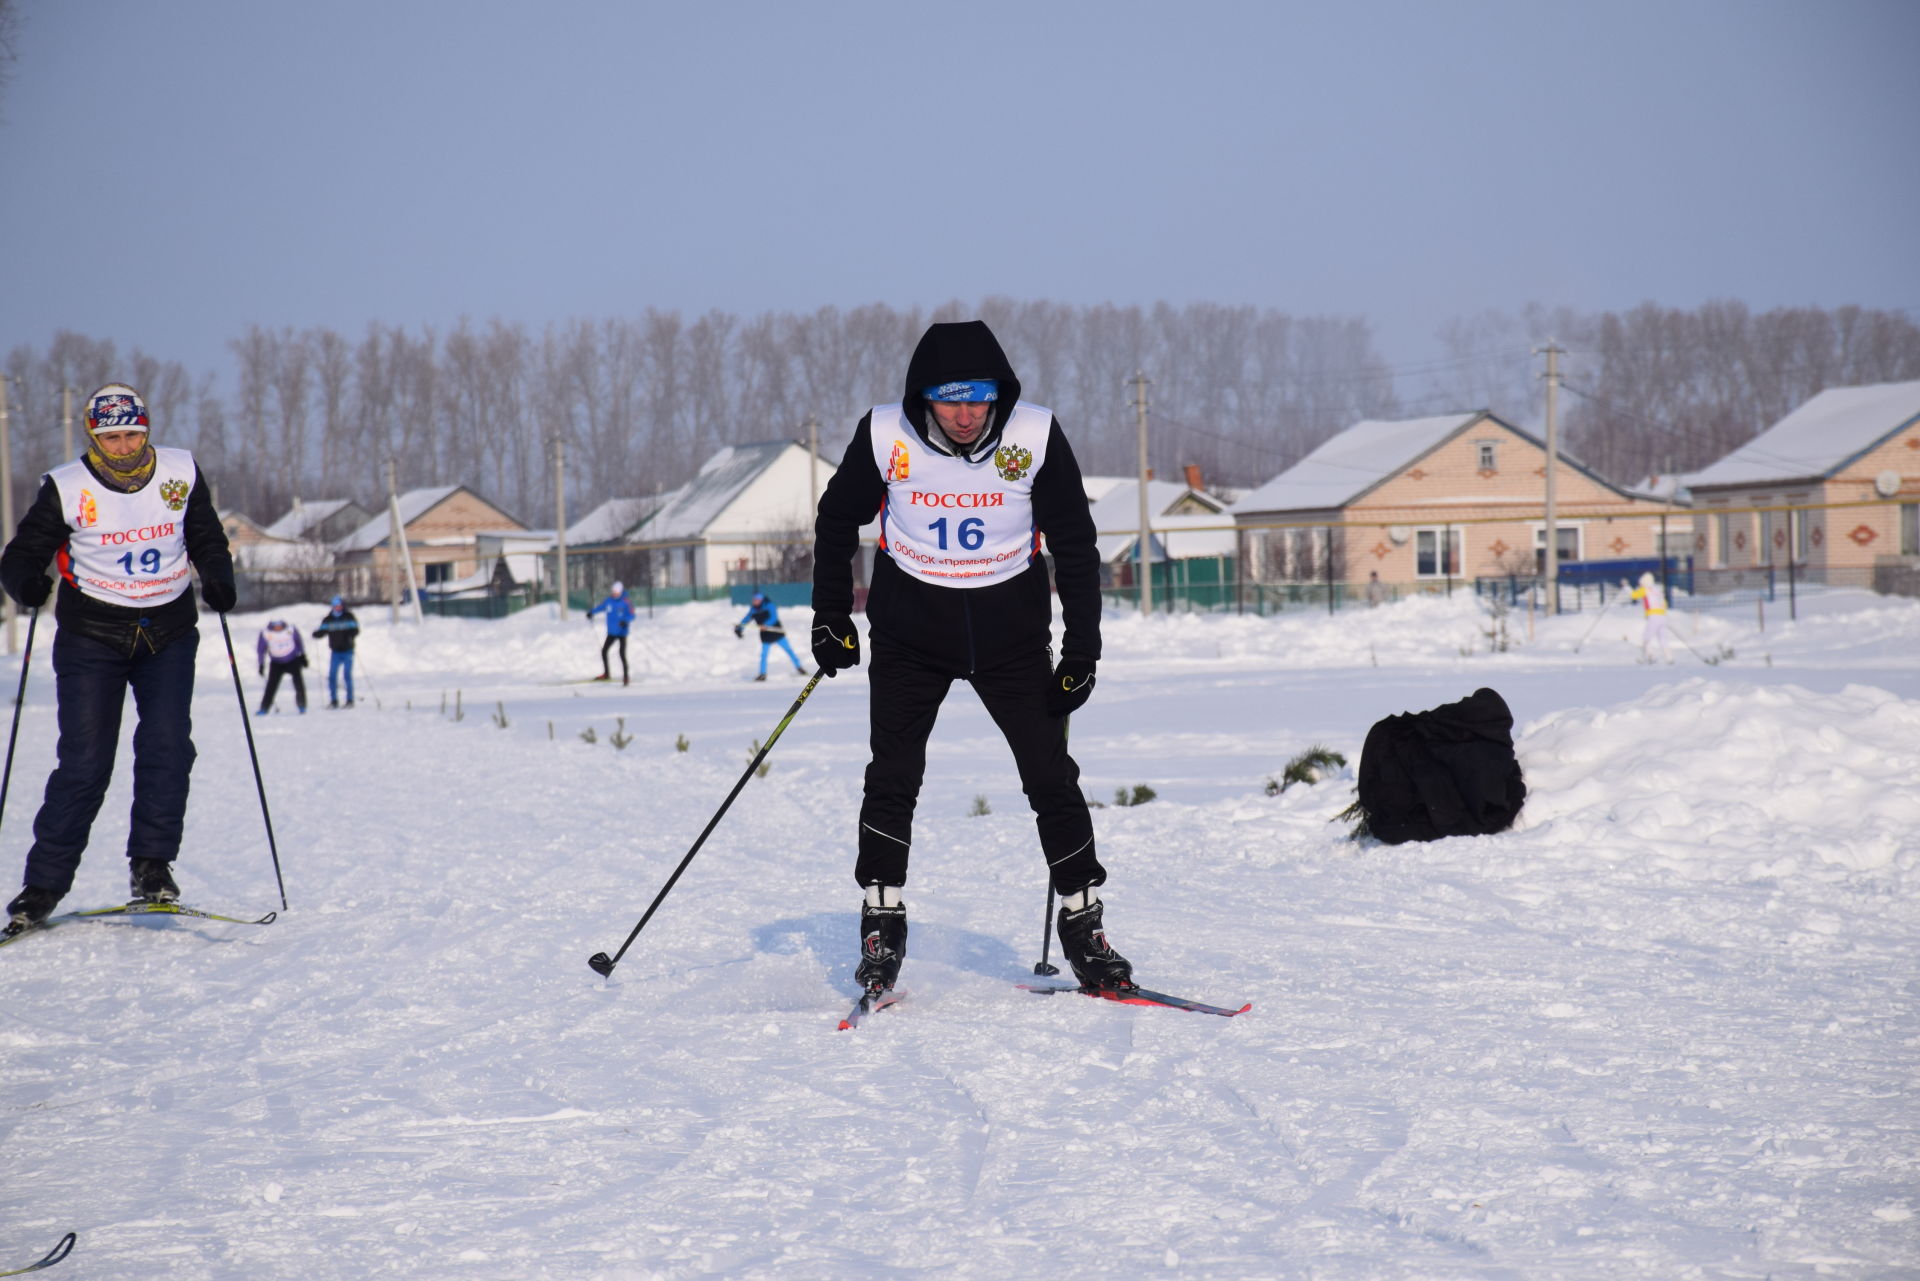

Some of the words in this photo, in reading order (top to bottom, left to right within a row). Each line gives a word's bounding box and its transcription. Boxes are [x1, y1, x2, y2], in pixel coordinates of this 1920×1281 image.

[97, 416, 137, 427] 2011
[911, 491, 1004, 508] РОССИЯ
[101, 522, 175, 545] РОССИЯ
[928, 517, 985, 551] 16
[117, 548, 161, 576] 19
